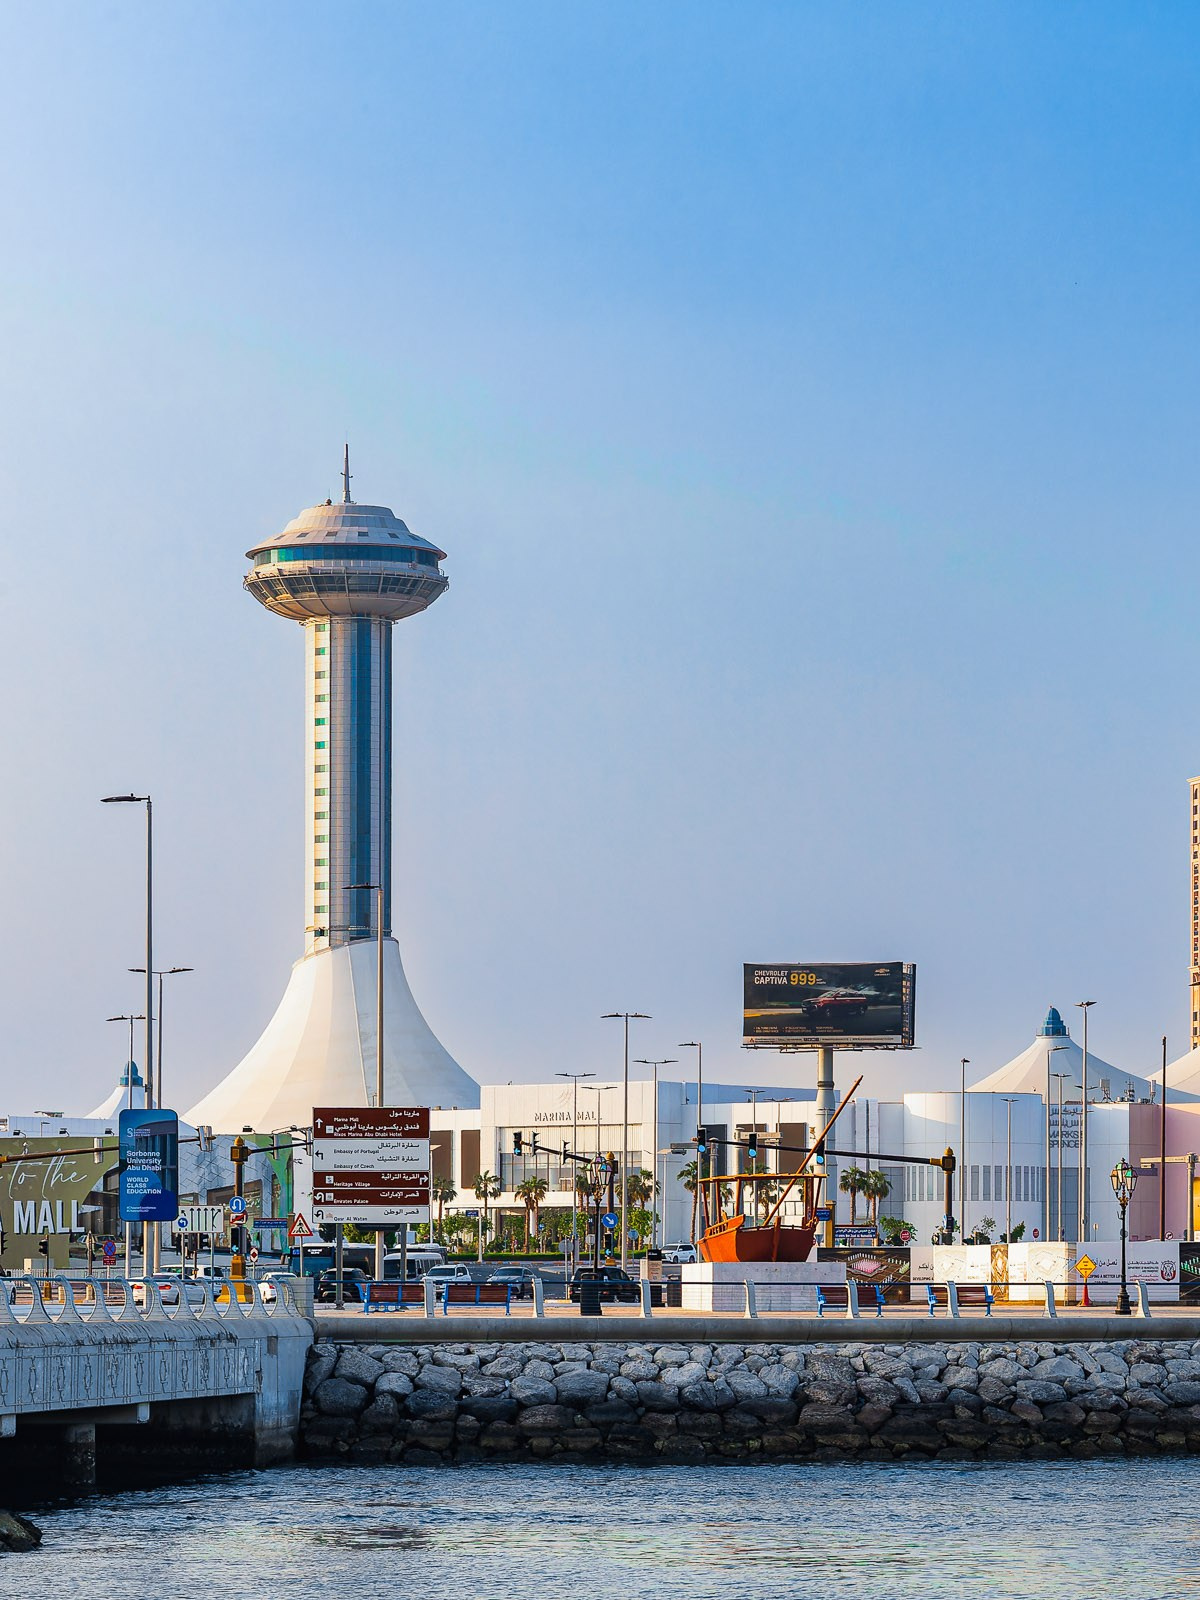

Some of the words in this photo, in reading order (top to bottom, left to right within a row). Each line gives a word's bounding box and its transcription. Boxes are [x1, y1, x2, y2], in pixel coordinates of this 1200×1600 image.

[790, 973, 816, 985] 999
[535, 1112, 571, 1121] MARINA
[335, 1122, 356, 1132] أبوظبي
[375, 1123, 402, 1131] ريكسوس
[127, 1157, 161, 1165] University
[13, 1200, 85, 1234] MALL
